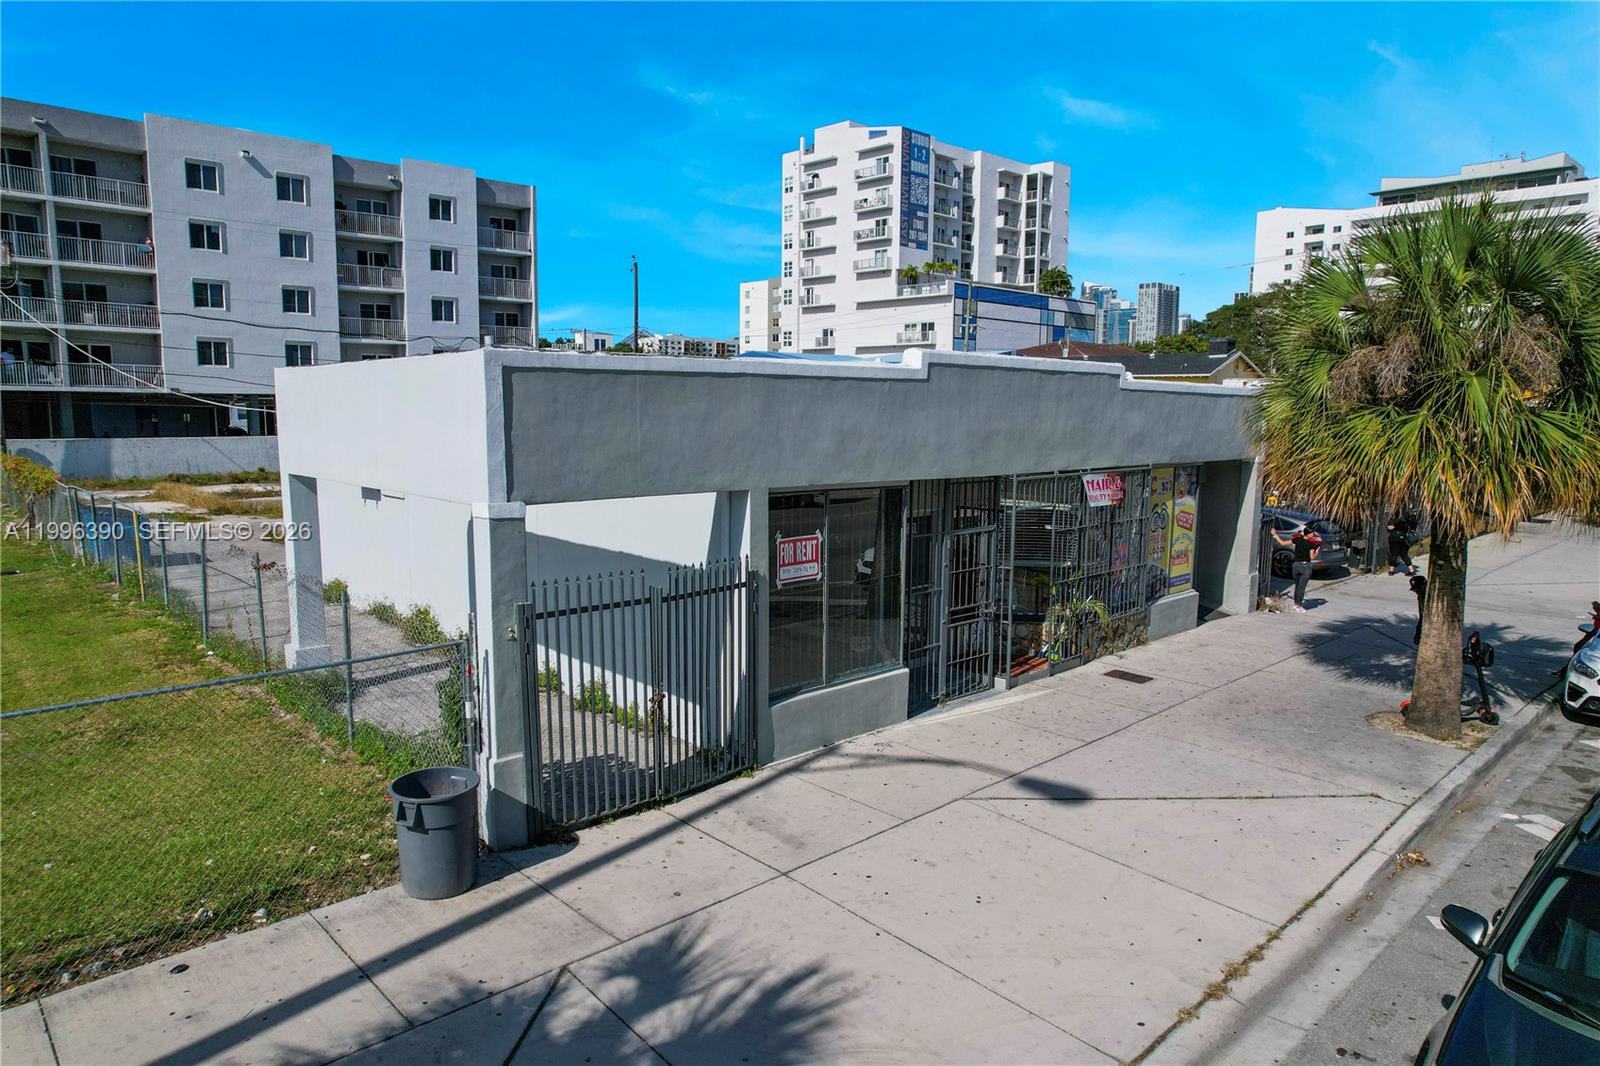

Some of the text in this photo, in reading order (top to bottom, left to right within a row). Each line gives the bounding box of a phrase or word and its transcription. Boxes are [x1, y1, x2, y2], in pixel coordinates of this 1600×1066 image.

[902, 130, 910, 172] LIVING
[901, 176, 909, 211] RIVER
[1086, 477, 1112, 491] HAIR
[780, 540, 817, 565] FOR RENT
